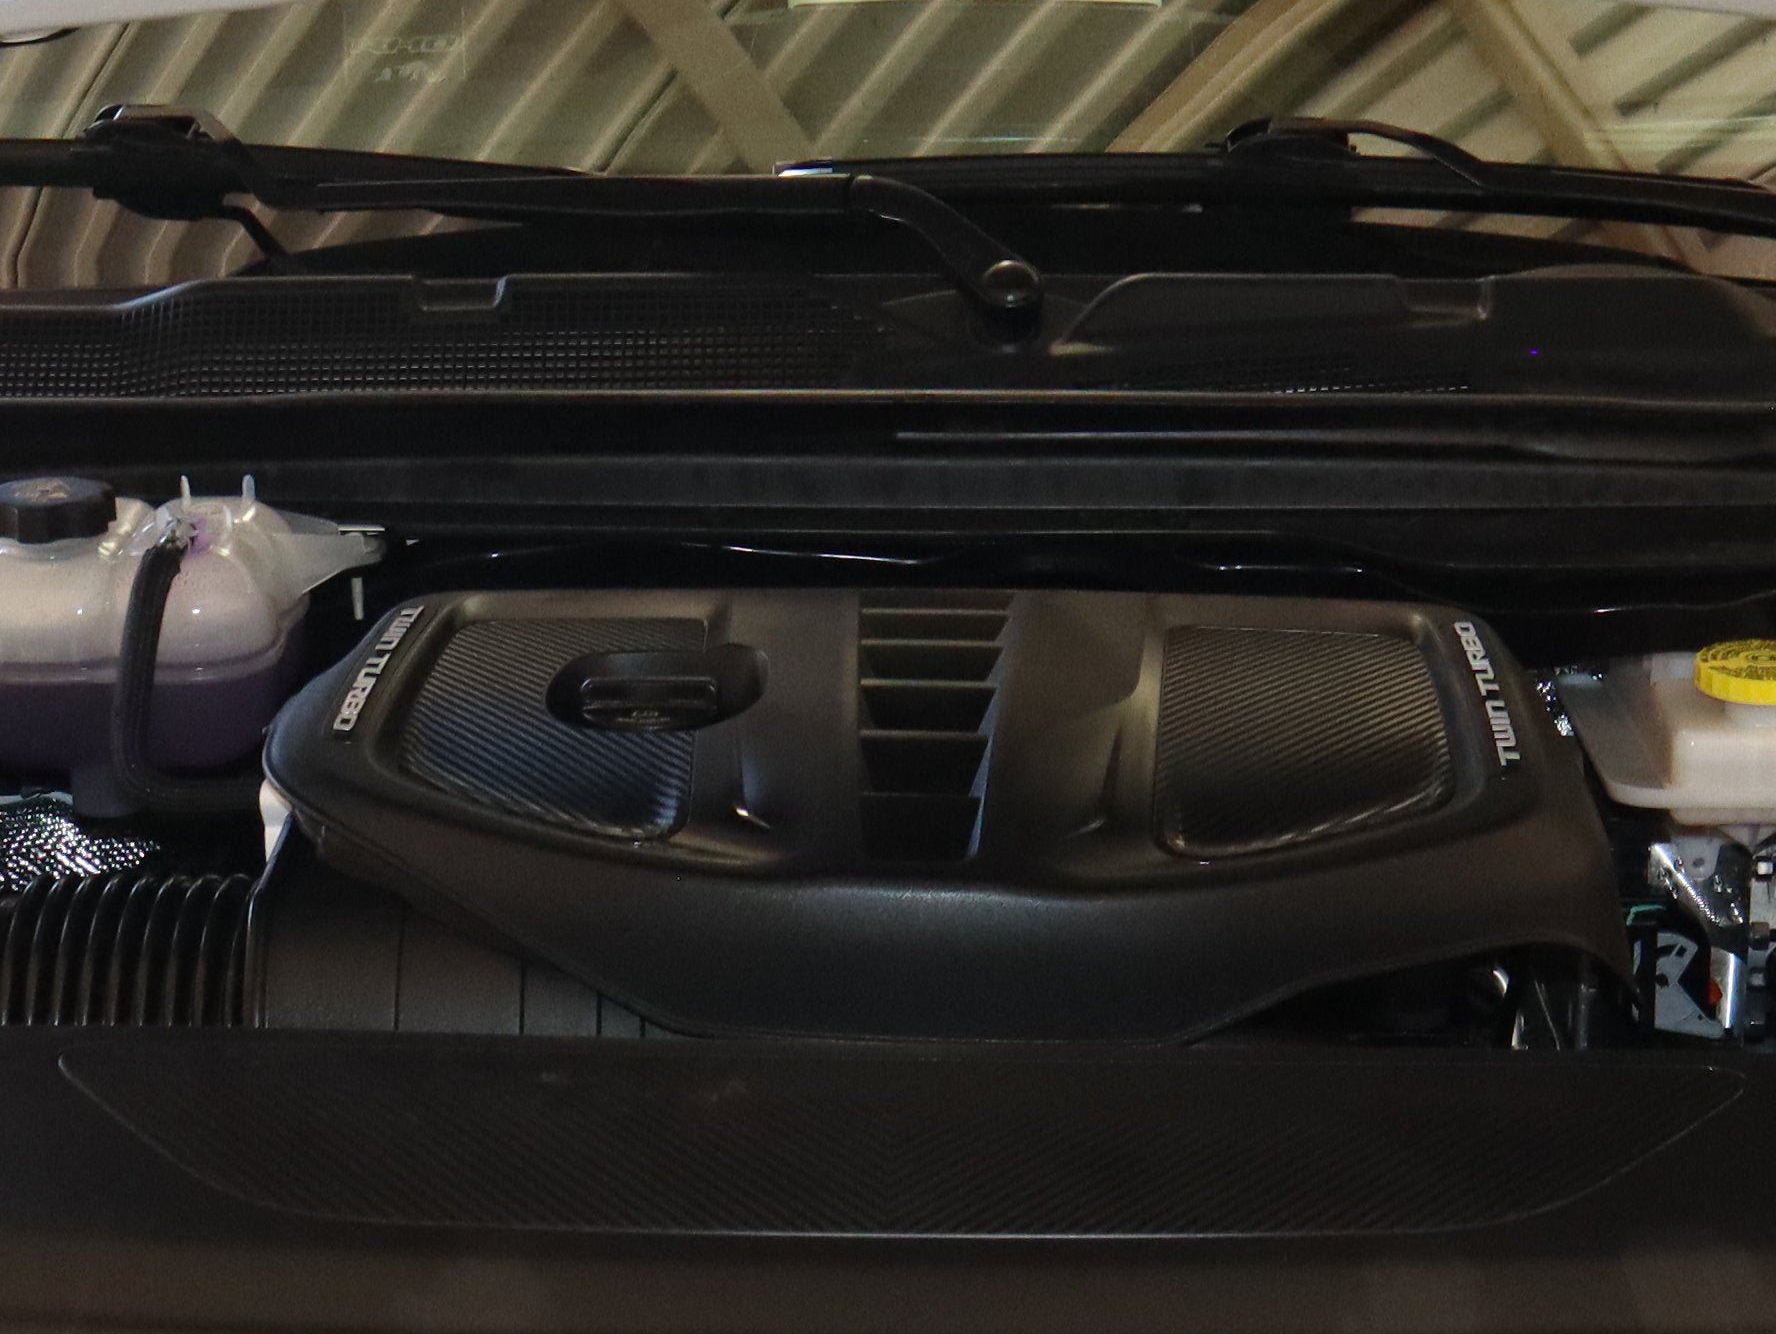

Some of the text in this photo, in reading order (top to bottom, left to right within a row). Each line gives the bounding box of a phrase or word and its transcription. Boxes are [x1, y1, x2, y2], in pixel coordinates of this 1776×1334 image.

[332, 605, 425, 732] TWIN TURBO
[1453, 621, 1521, 767] TWIN TURBO
